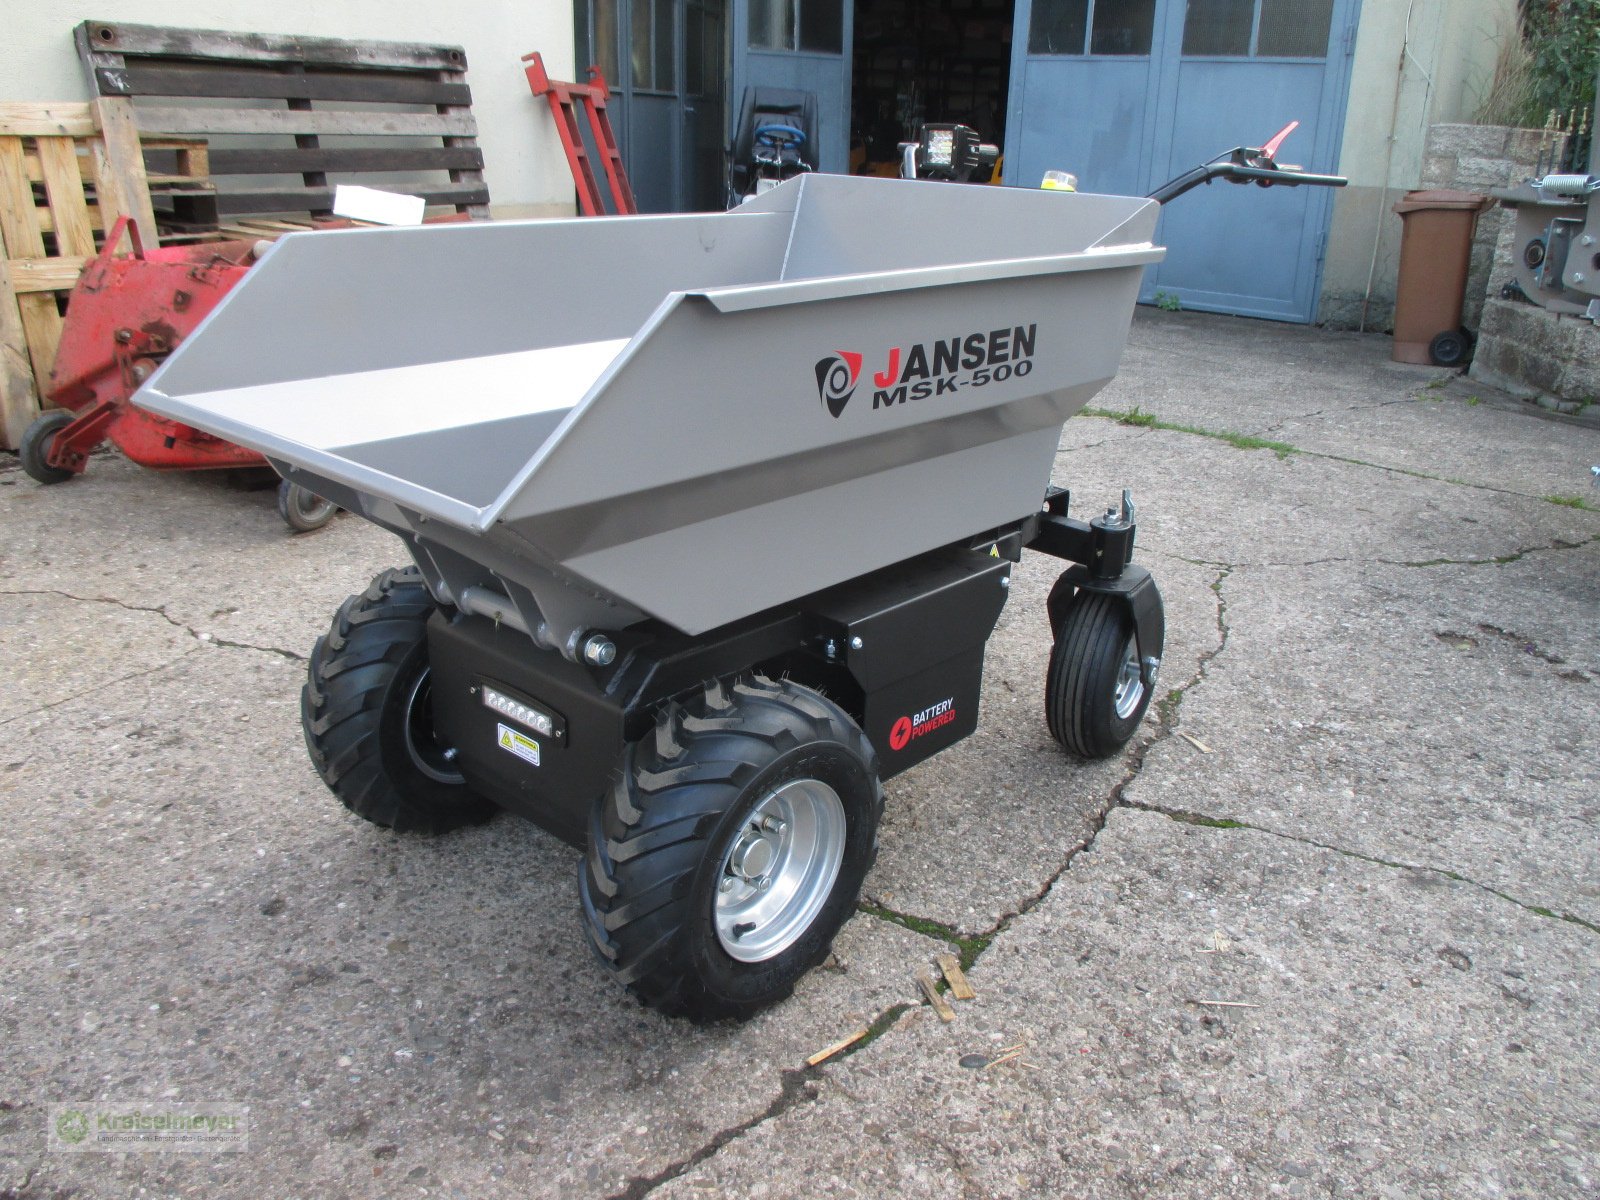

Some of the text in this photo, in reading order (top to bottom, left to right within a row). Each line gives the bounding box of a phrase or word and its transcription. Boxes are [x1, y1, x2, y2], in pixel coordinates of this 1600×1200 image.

[873, 323, 1038, 389] JANSEN
[872, 359, 1033, 410] MSK-500
[911, 709, 957, 740] POWERED
[912, 697, 954, 727] BATTERY
